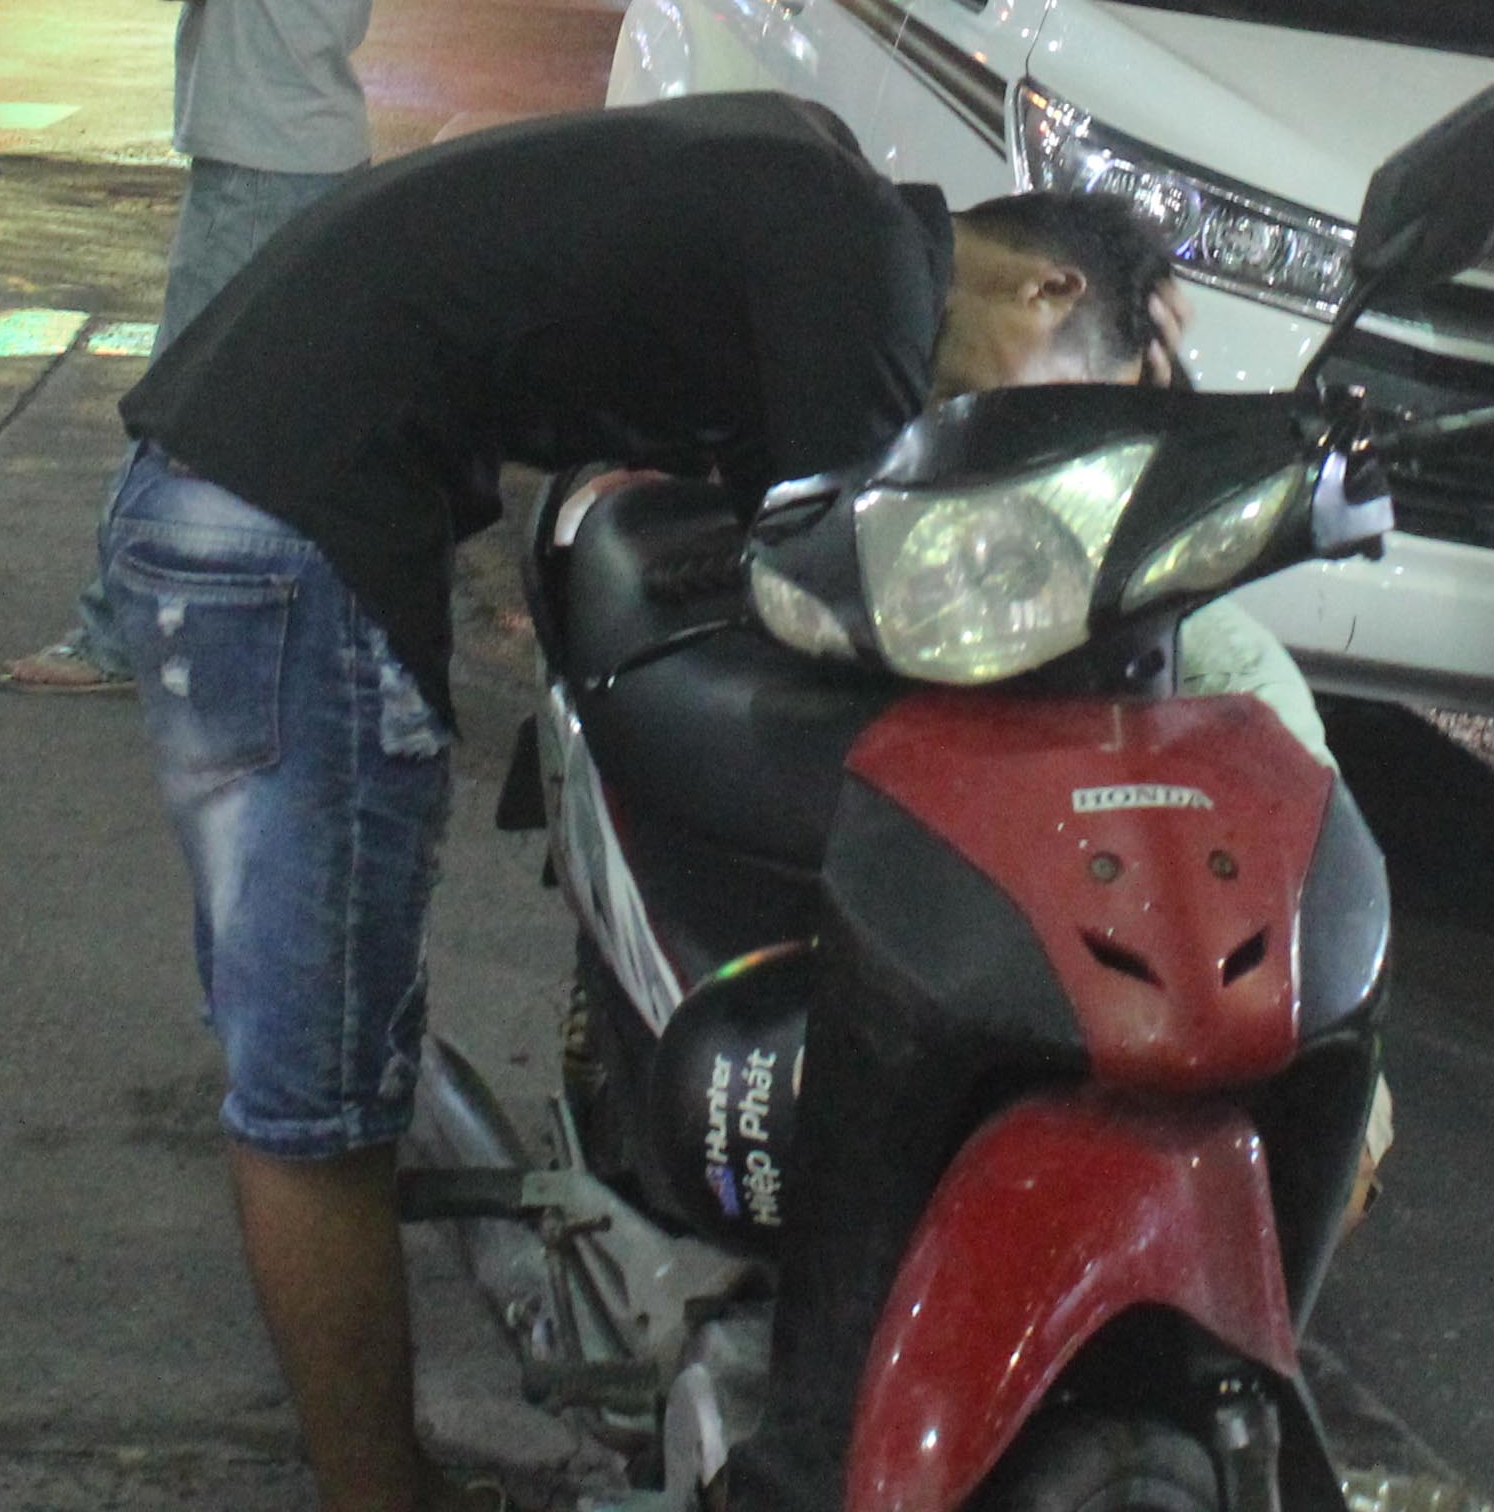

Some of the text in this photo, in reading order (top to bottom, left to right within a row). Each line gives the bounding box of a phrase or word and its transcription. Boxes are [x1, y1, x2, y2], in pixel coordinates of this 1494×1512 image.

[1077, 786, 1211, 810] HONDA
[705, 1053, 732, 1165] Hunter
[738, 1048, 782, 1226] Hiệp Phát
